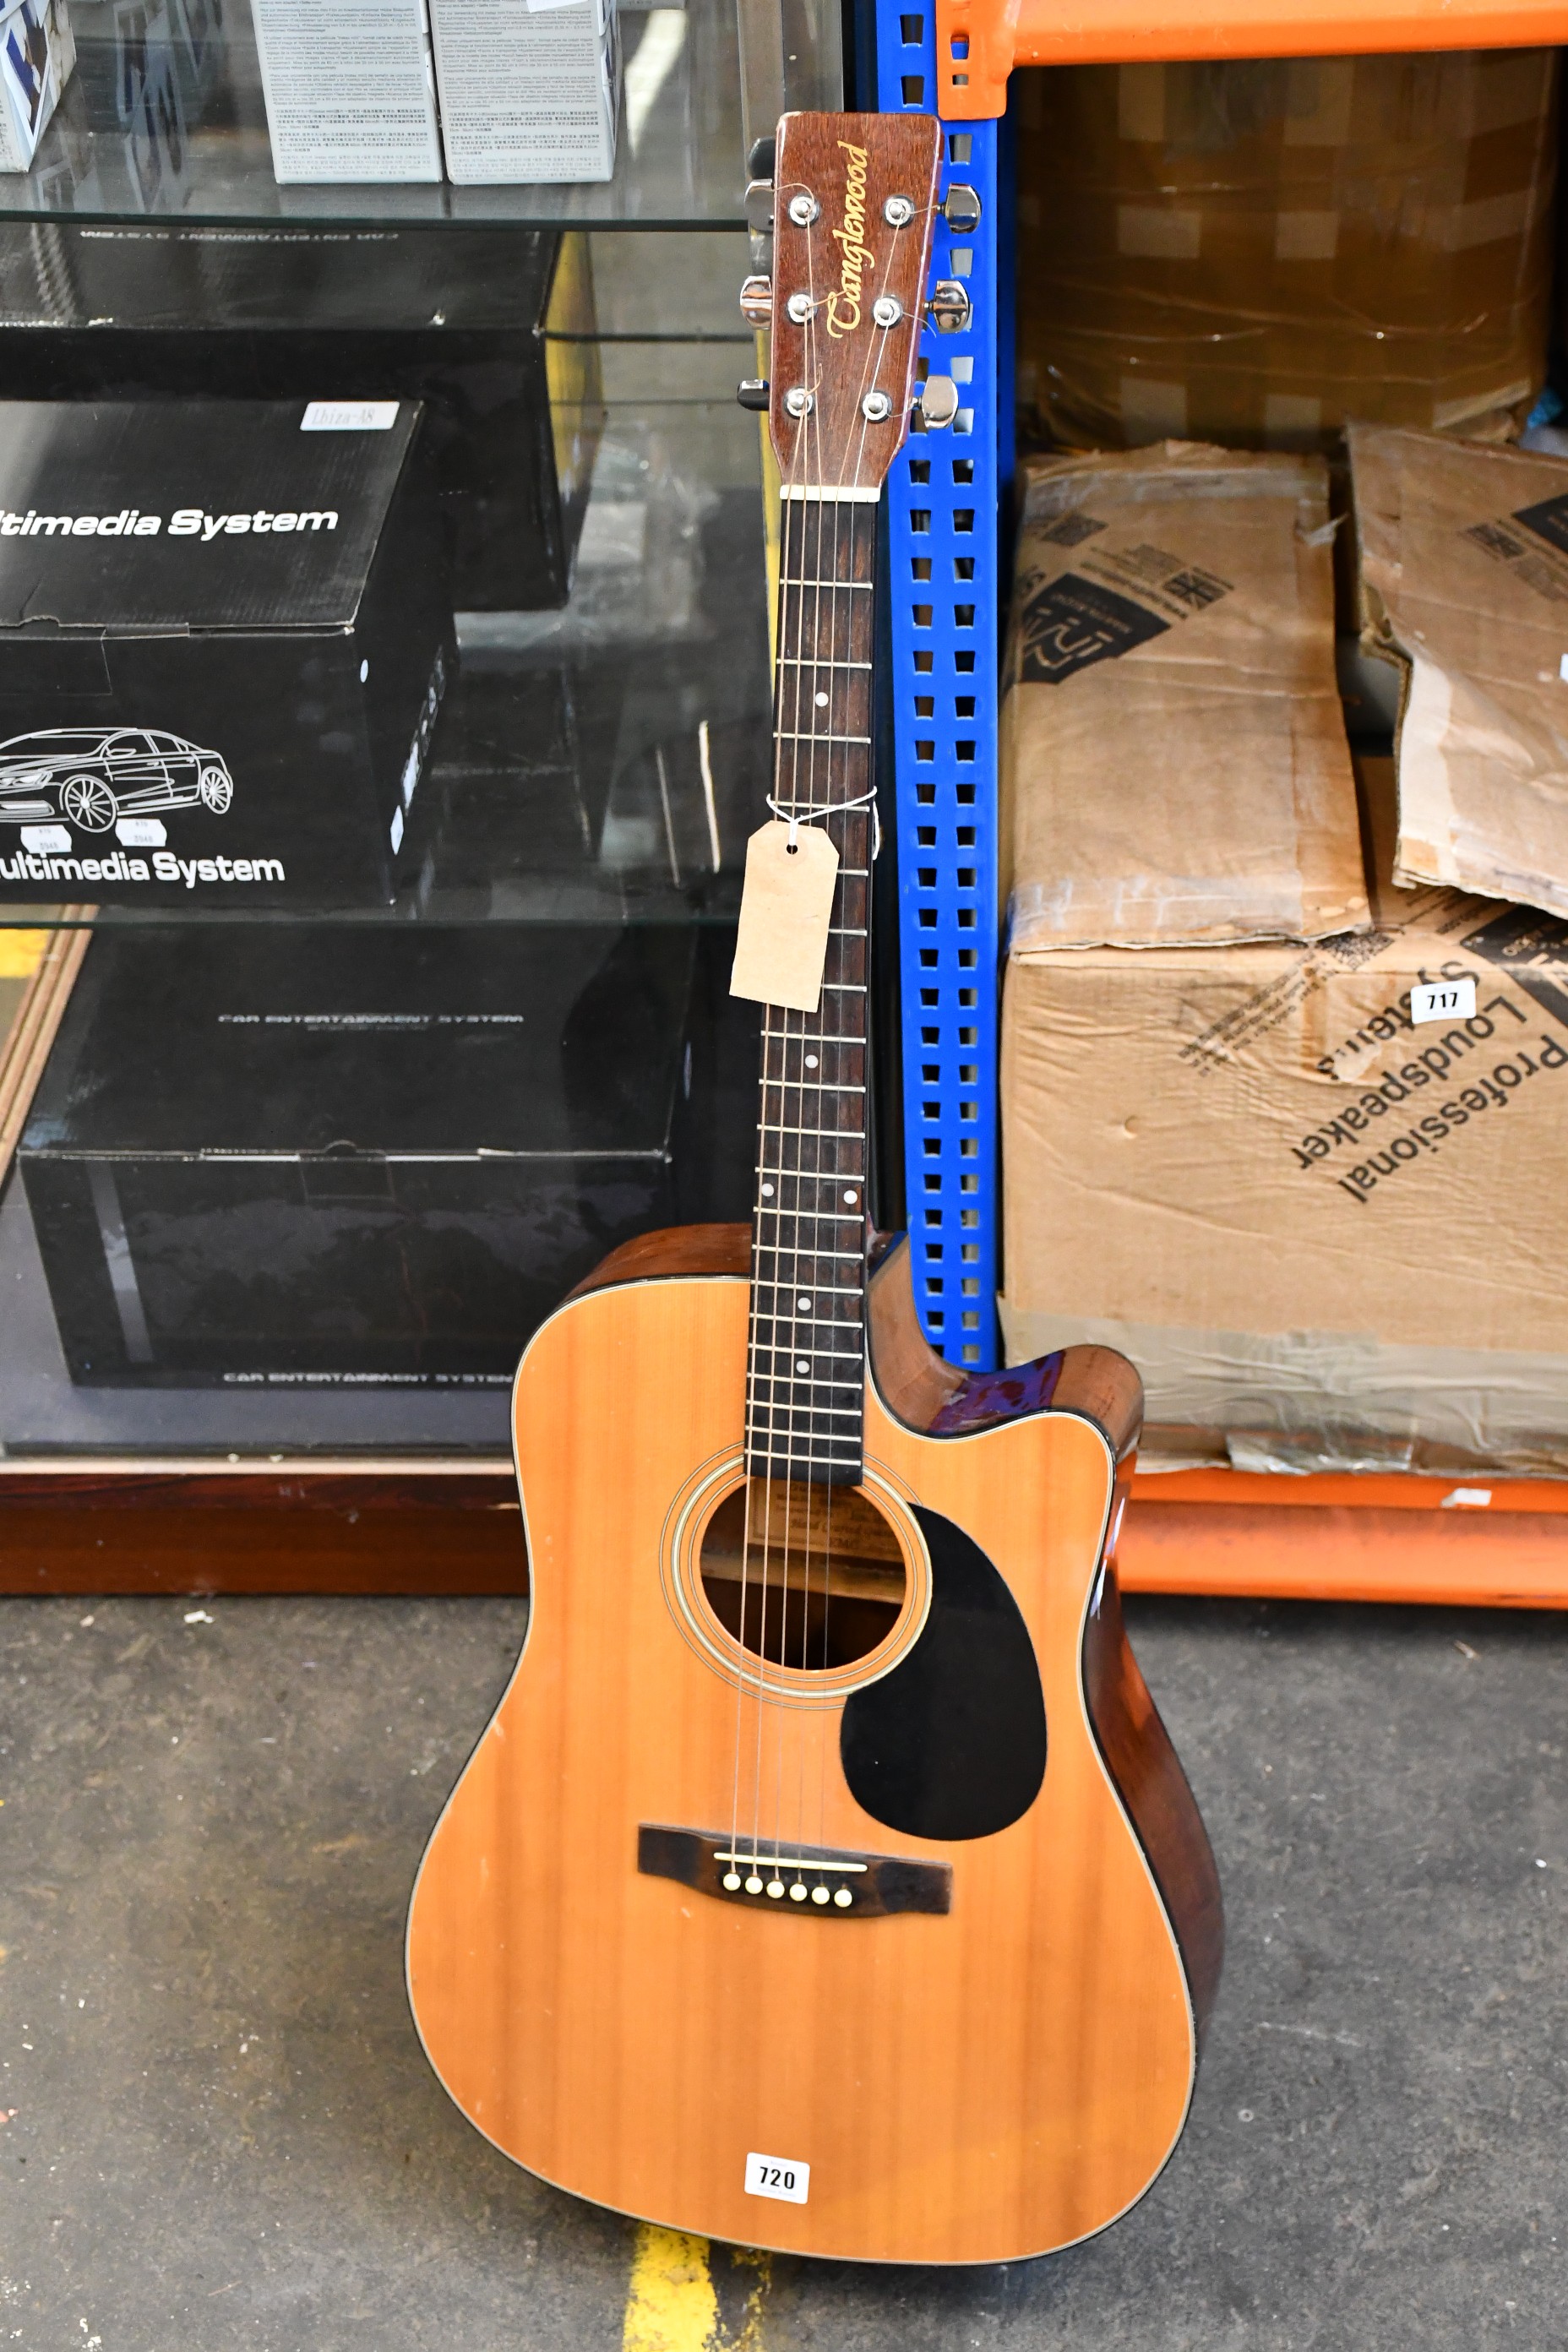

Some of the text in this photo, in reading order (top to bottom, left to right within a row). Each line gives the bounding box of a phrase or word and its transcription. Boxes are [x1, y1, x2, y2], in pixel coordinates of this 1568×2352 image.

[0, 509, 339, 542] timedia System
[0, 850, 286, 889] ultimedia System
[1426, 992, 1458, 1010] 717
[1290, 995, 1527, 1170] Loudspeaker
[1337, 1033, 1568, 1204] Professional
[760, 2166, 795, 2190] 720
